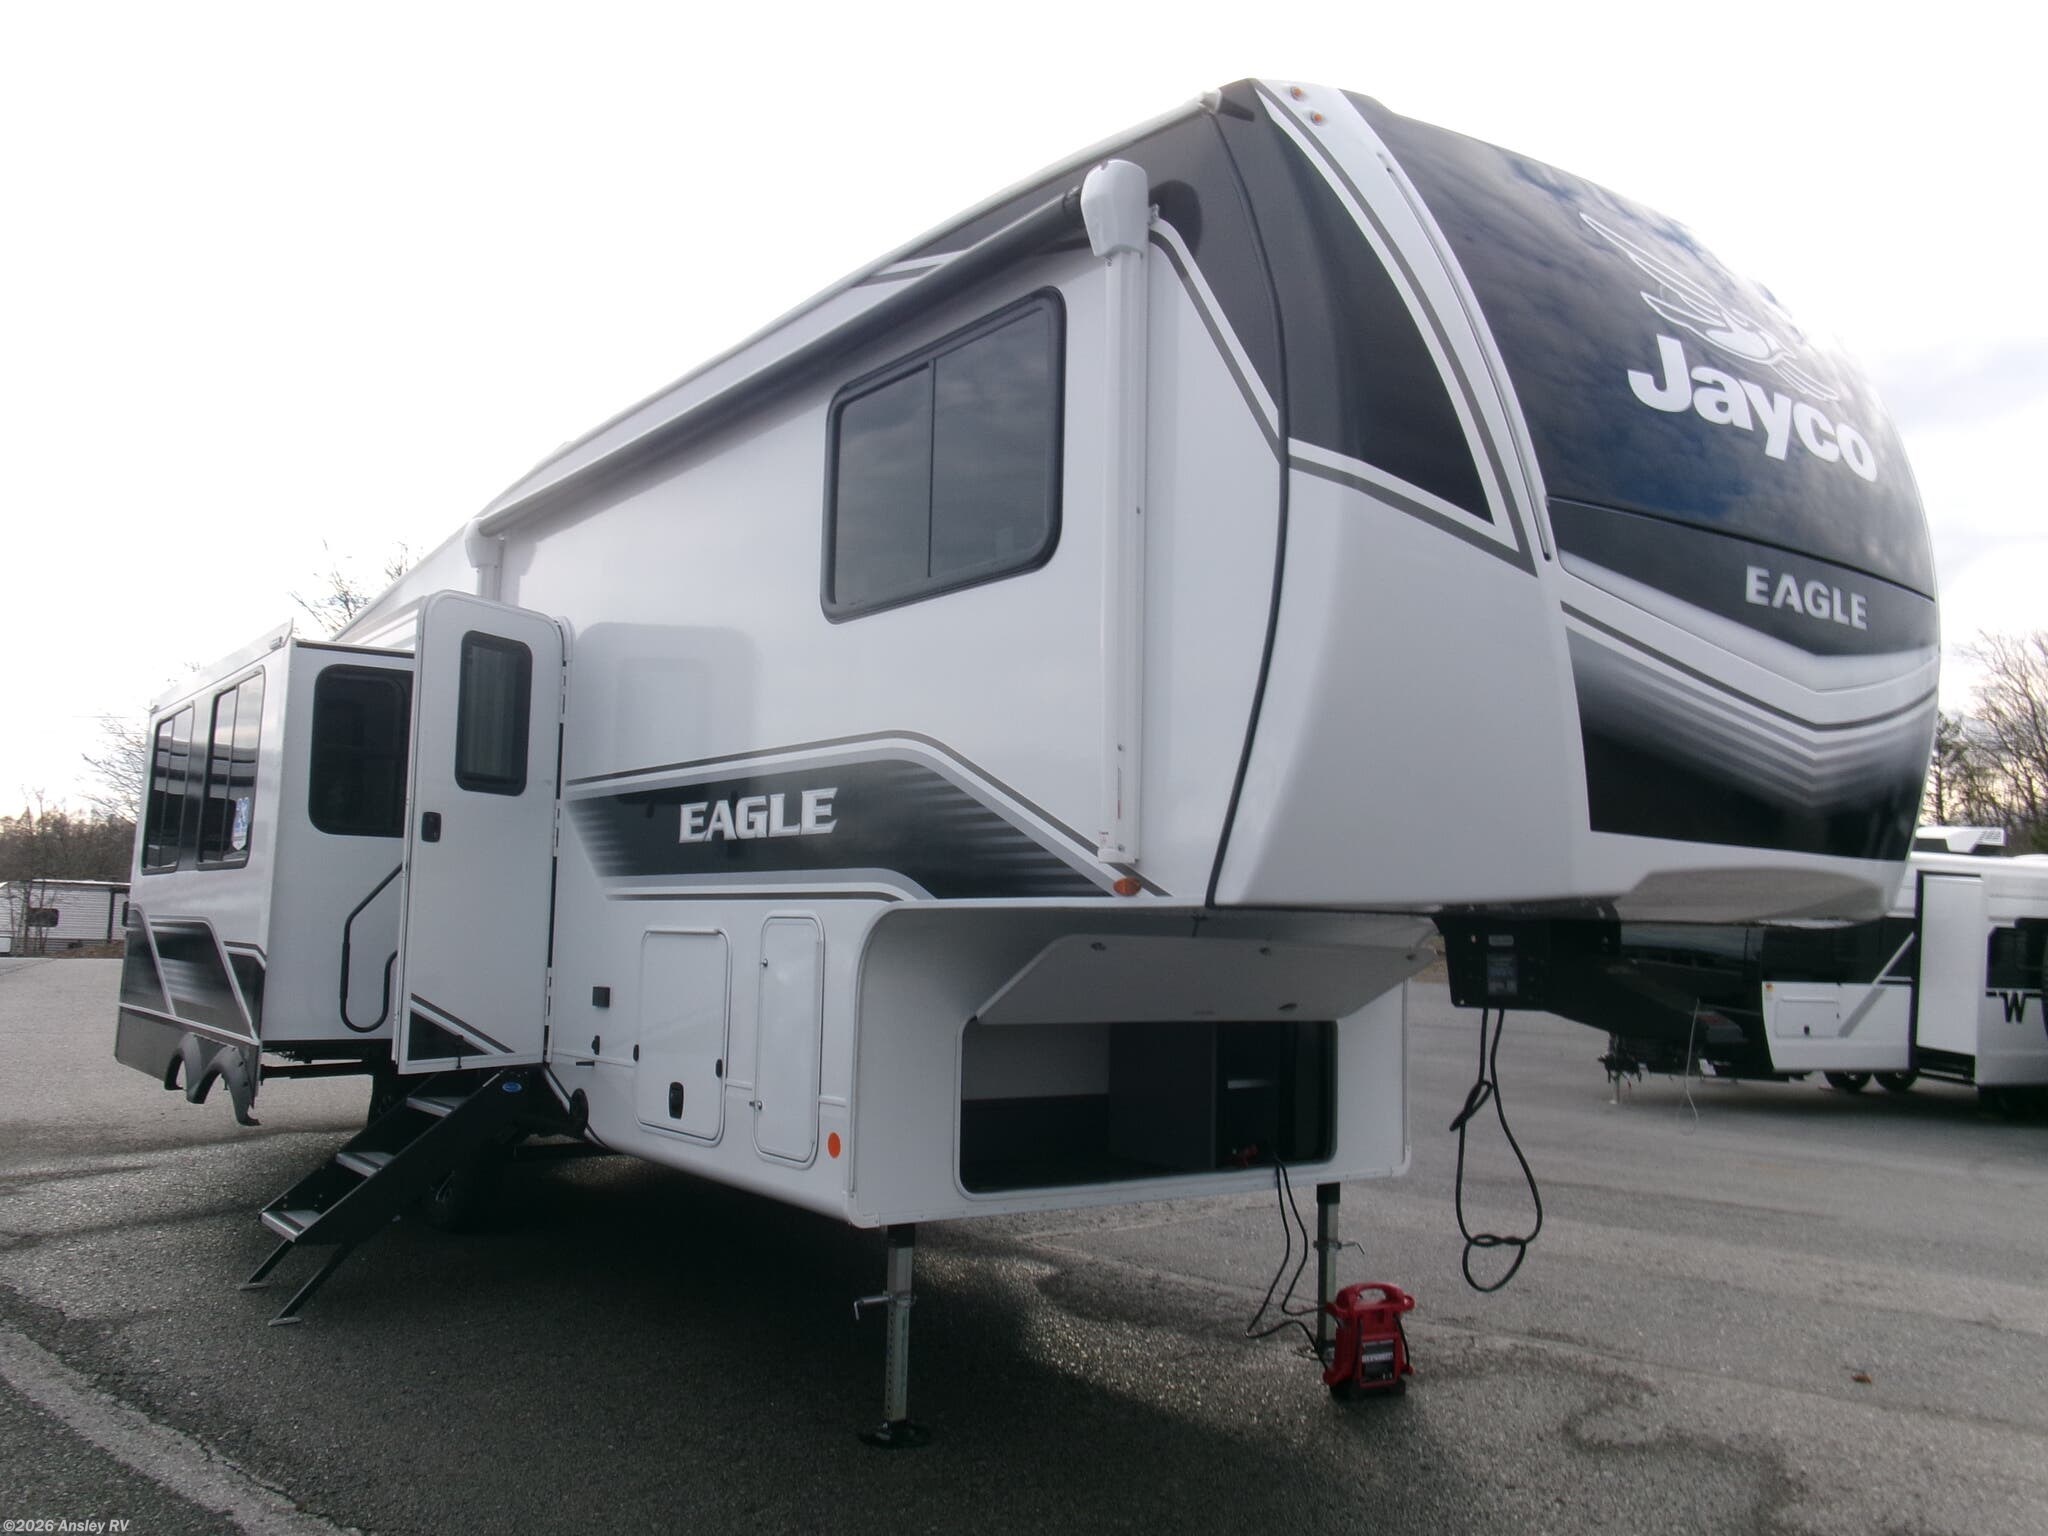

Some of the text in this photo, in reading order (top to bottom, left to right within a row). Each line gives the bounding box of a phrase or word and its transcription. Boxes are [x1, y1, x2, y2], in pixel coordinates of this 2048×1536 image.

[1627, 333, 1877, 483] Jayco
[1746, 566, 1868, 630] EAGLE
[679, 787, 839, 844] EAGLE
